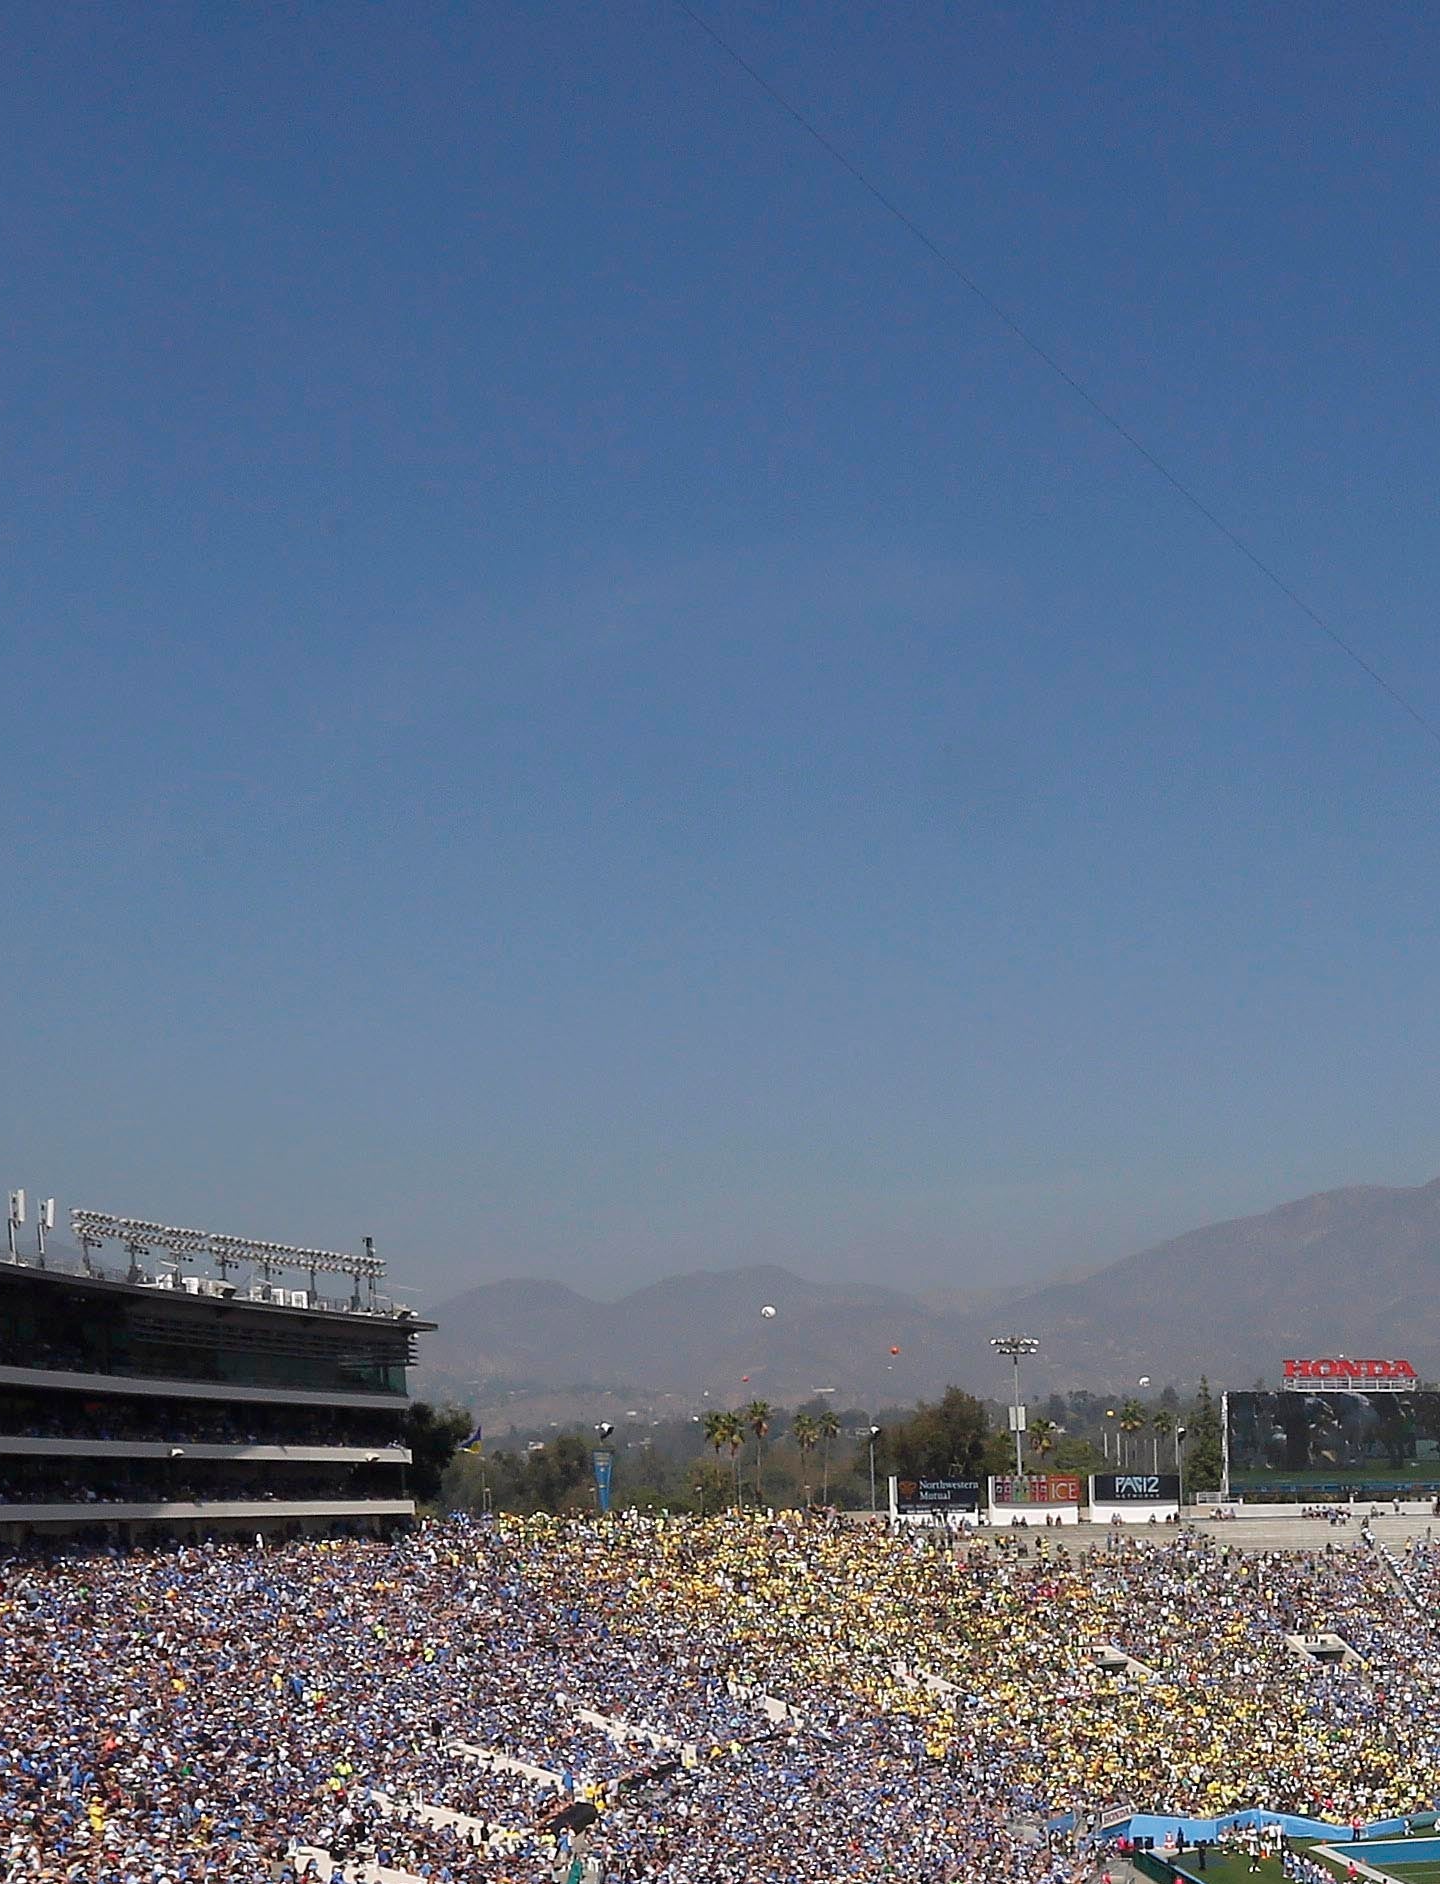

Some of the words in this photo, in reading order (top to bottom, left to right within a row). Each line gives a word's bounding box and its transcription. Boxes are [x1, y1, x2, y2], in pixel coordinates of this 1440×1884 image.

[1283, 1359, 1418, 1377] HONDA
[919, 1479, 980, 1490] Northwestern
[1051, 1482, 1078, 1500] ICE
[919, 1490, 951, 1500] Mutual
